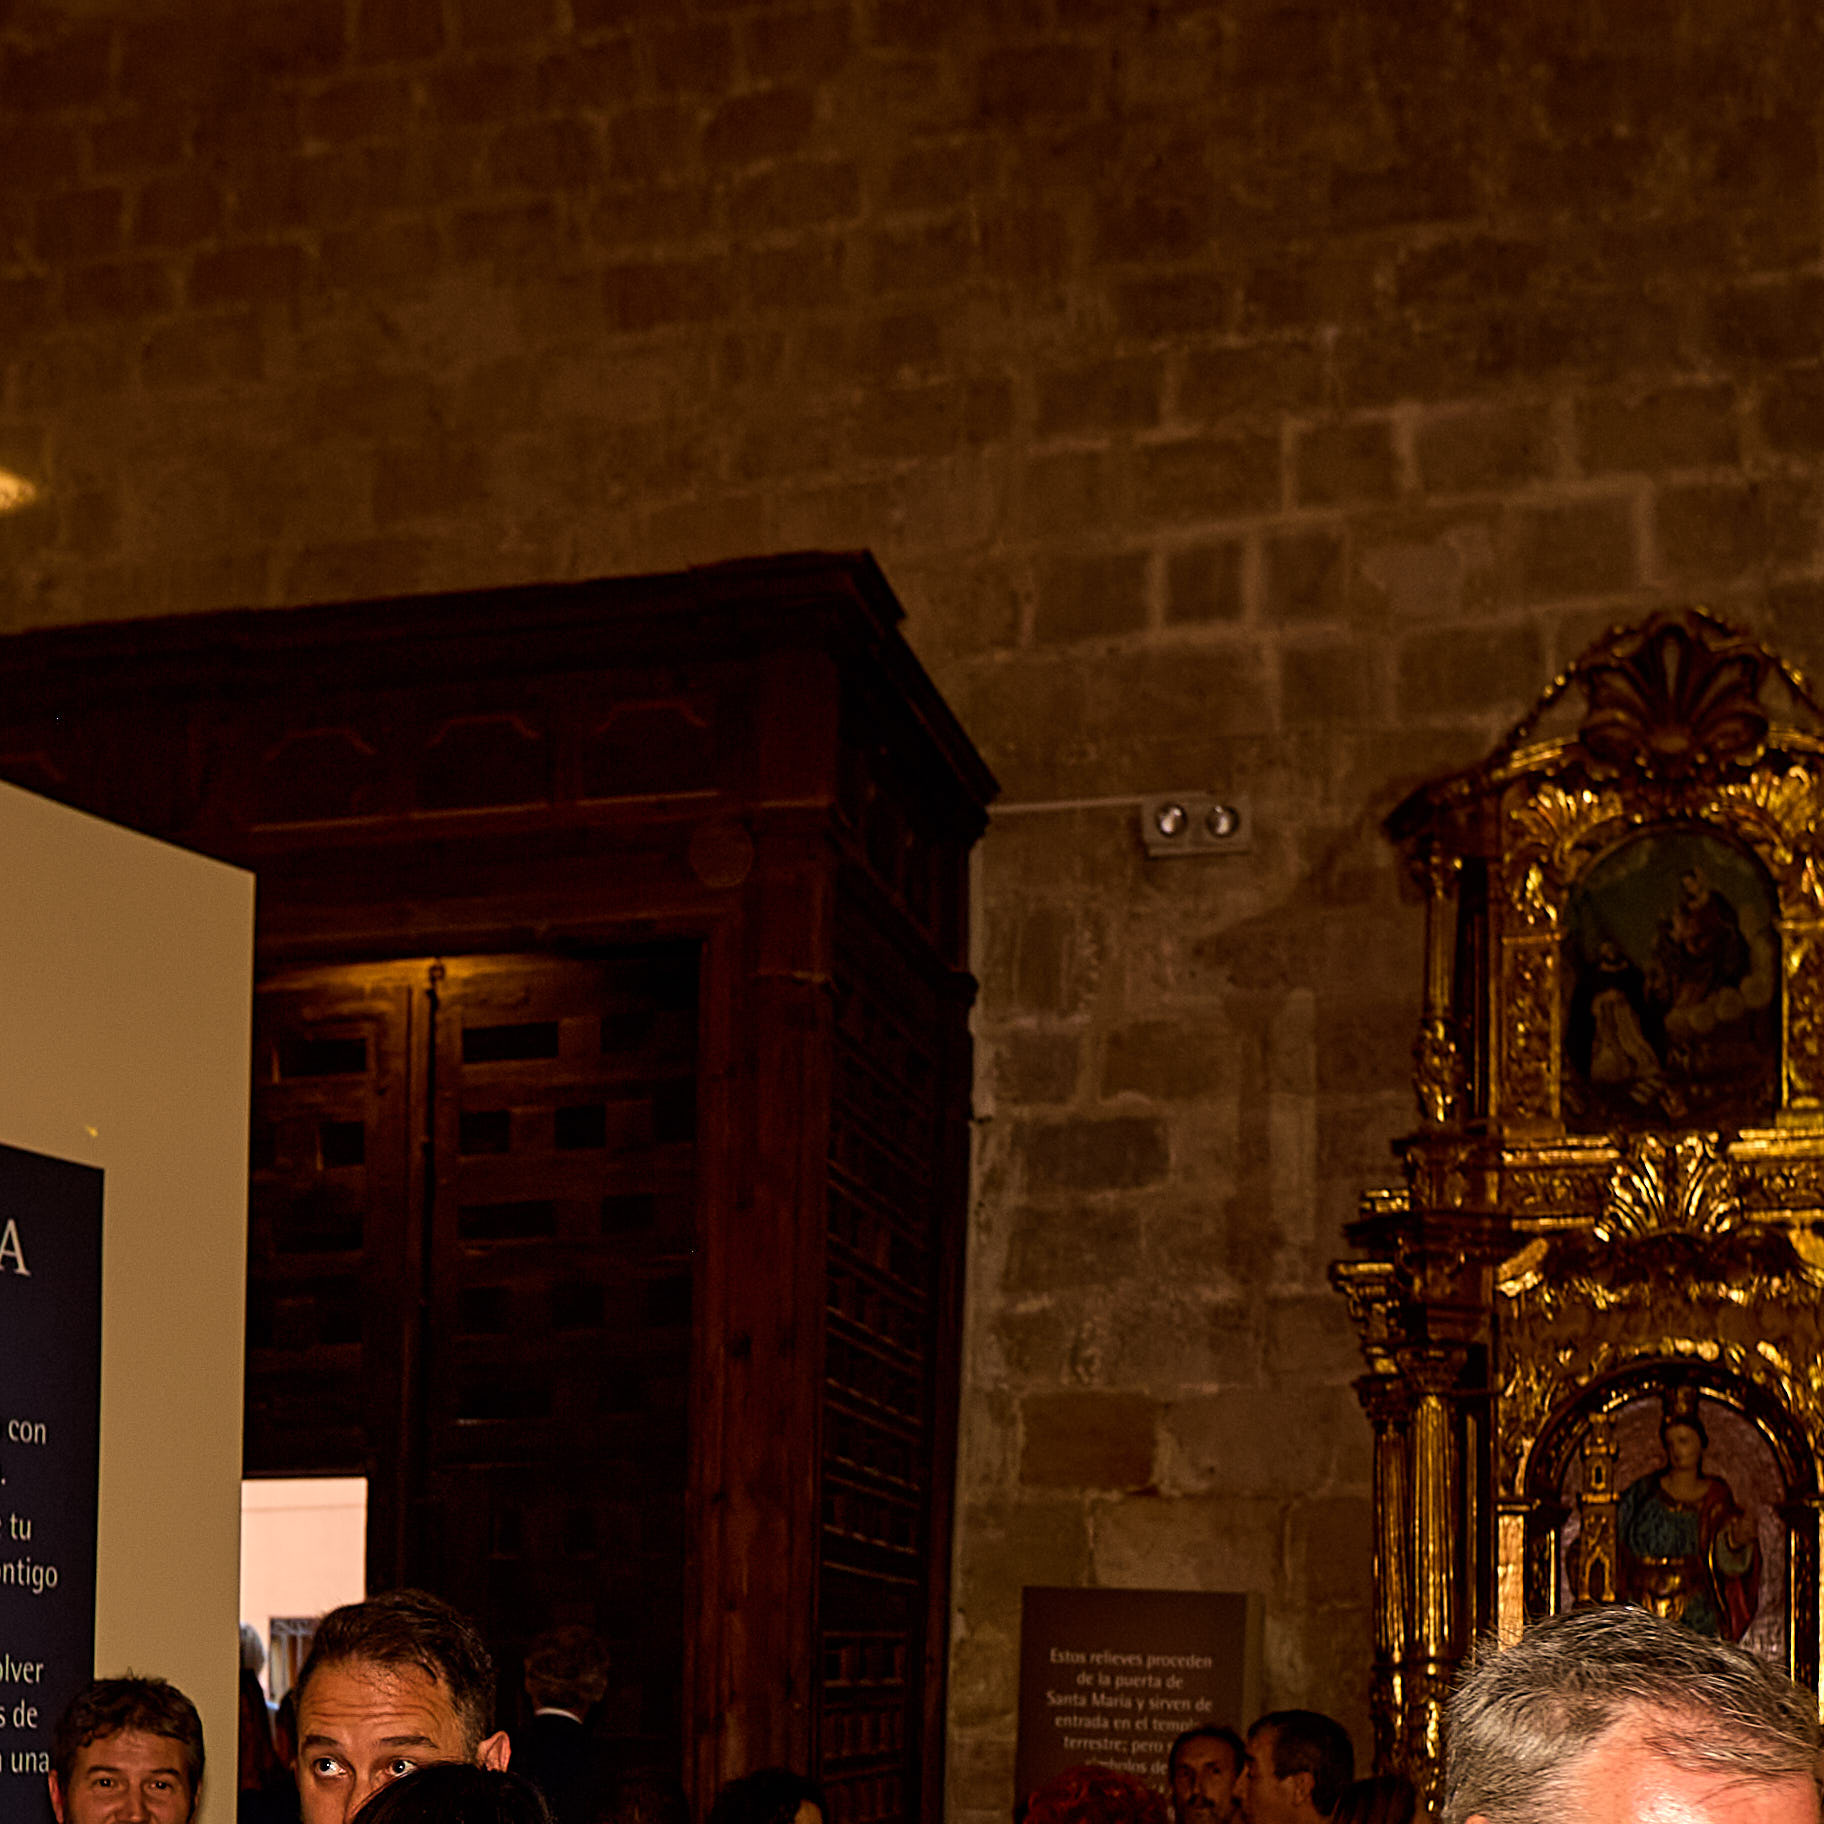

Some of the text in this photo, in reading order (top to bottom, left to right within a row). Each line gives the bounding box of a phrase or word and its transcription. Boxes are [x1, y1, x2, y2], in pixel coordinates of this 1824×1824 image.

[8, 1418, 46, 1445] con
[10, 1512, 32, 1541] tu
[1049, 1648, 1212, 1670] Estos relieves proceden
[1076, 1671, 1184, 1690] de la puerta de
[1046, 1690, 1088, 1706] Santa
[1136, 1698, 1145, 1713] y
[1149, 1695, 1191, 1711] sirven
[1195, 1697, 1214, 1712] de
[12, 1698, 38, 1729] de
[1055, 1714, 1198, 1733] entrada en el templ
[1131, 1740, 1164, 1756] pero
[10, 1750, 50, 1774] una
